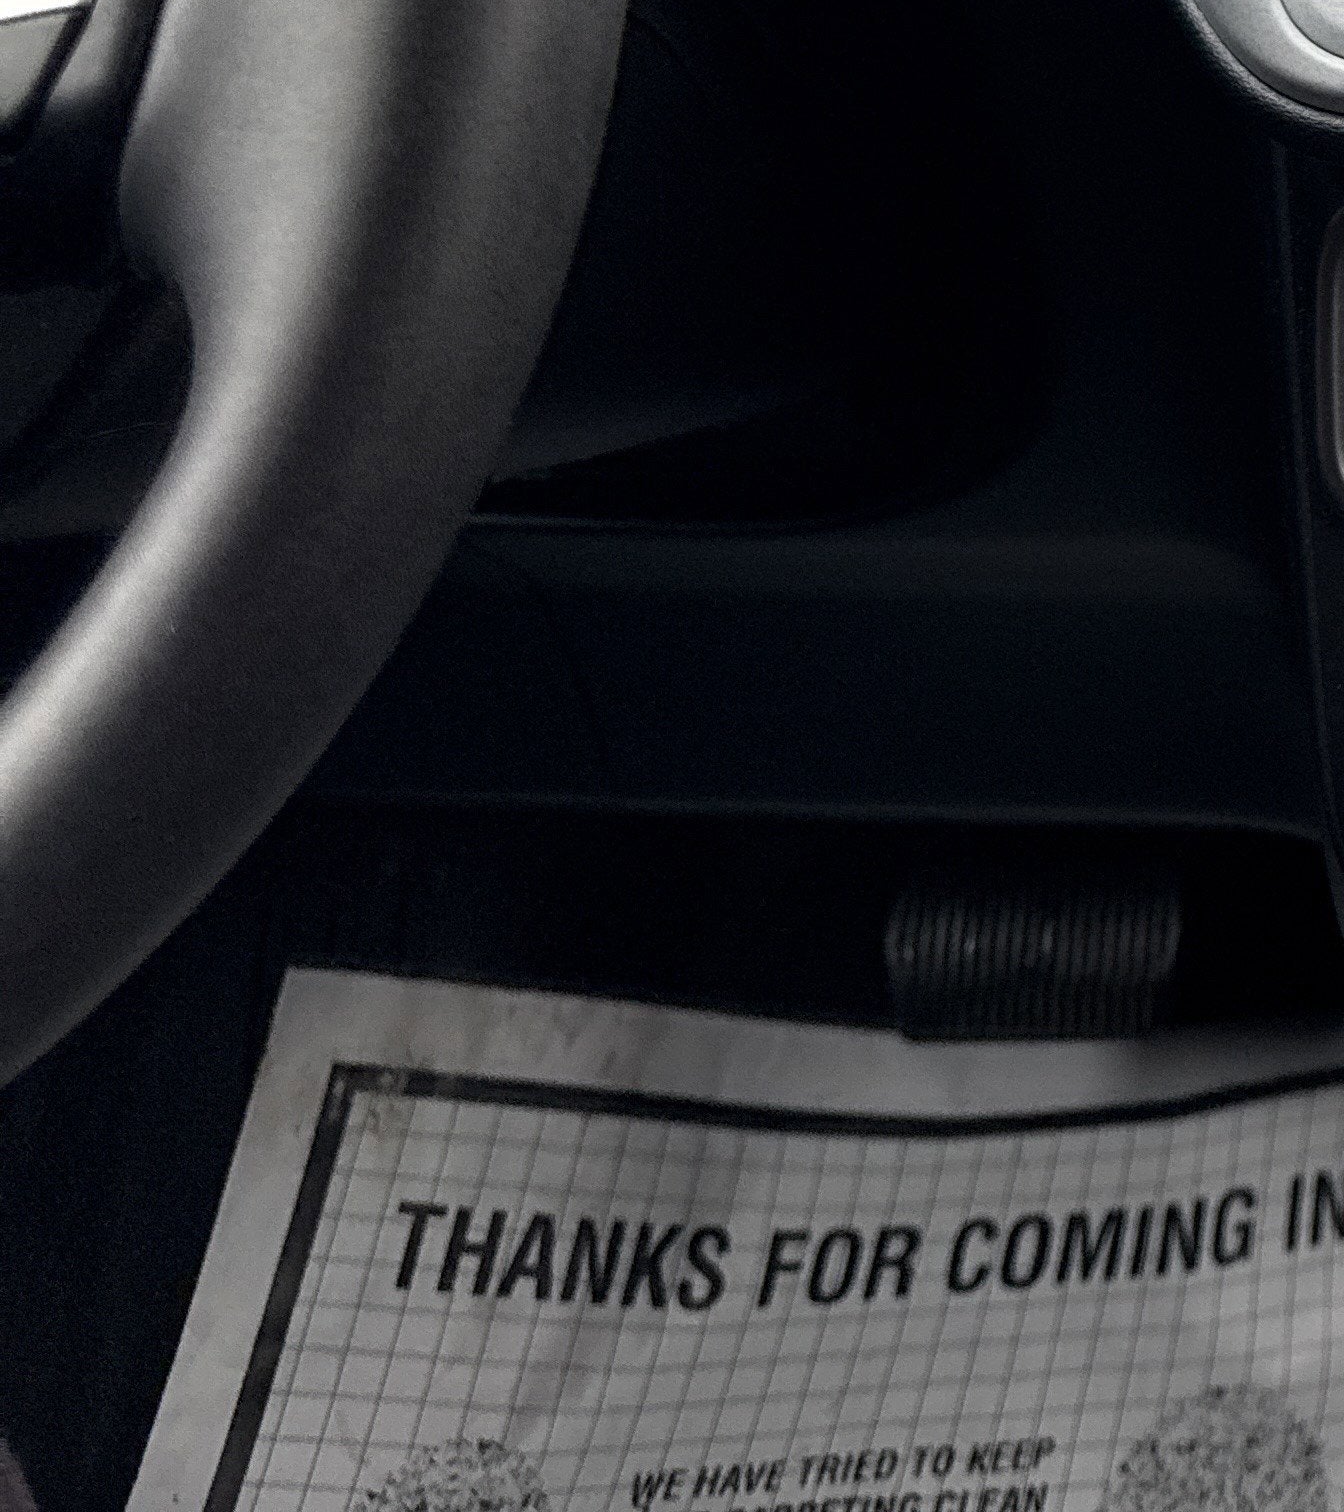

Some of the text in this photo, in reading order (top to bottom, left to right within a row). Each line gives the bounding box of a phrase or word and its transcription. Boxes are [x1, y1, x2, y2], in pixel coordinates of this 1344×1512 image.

[396, 1199, 732, 1314] THANKS
[757, 1223, 924, 1309] FOR
[946, 1185, 1257, 1295] COMING
[632, 1435, 1057, 1512] WE HAVE TRIED TO KEEP
